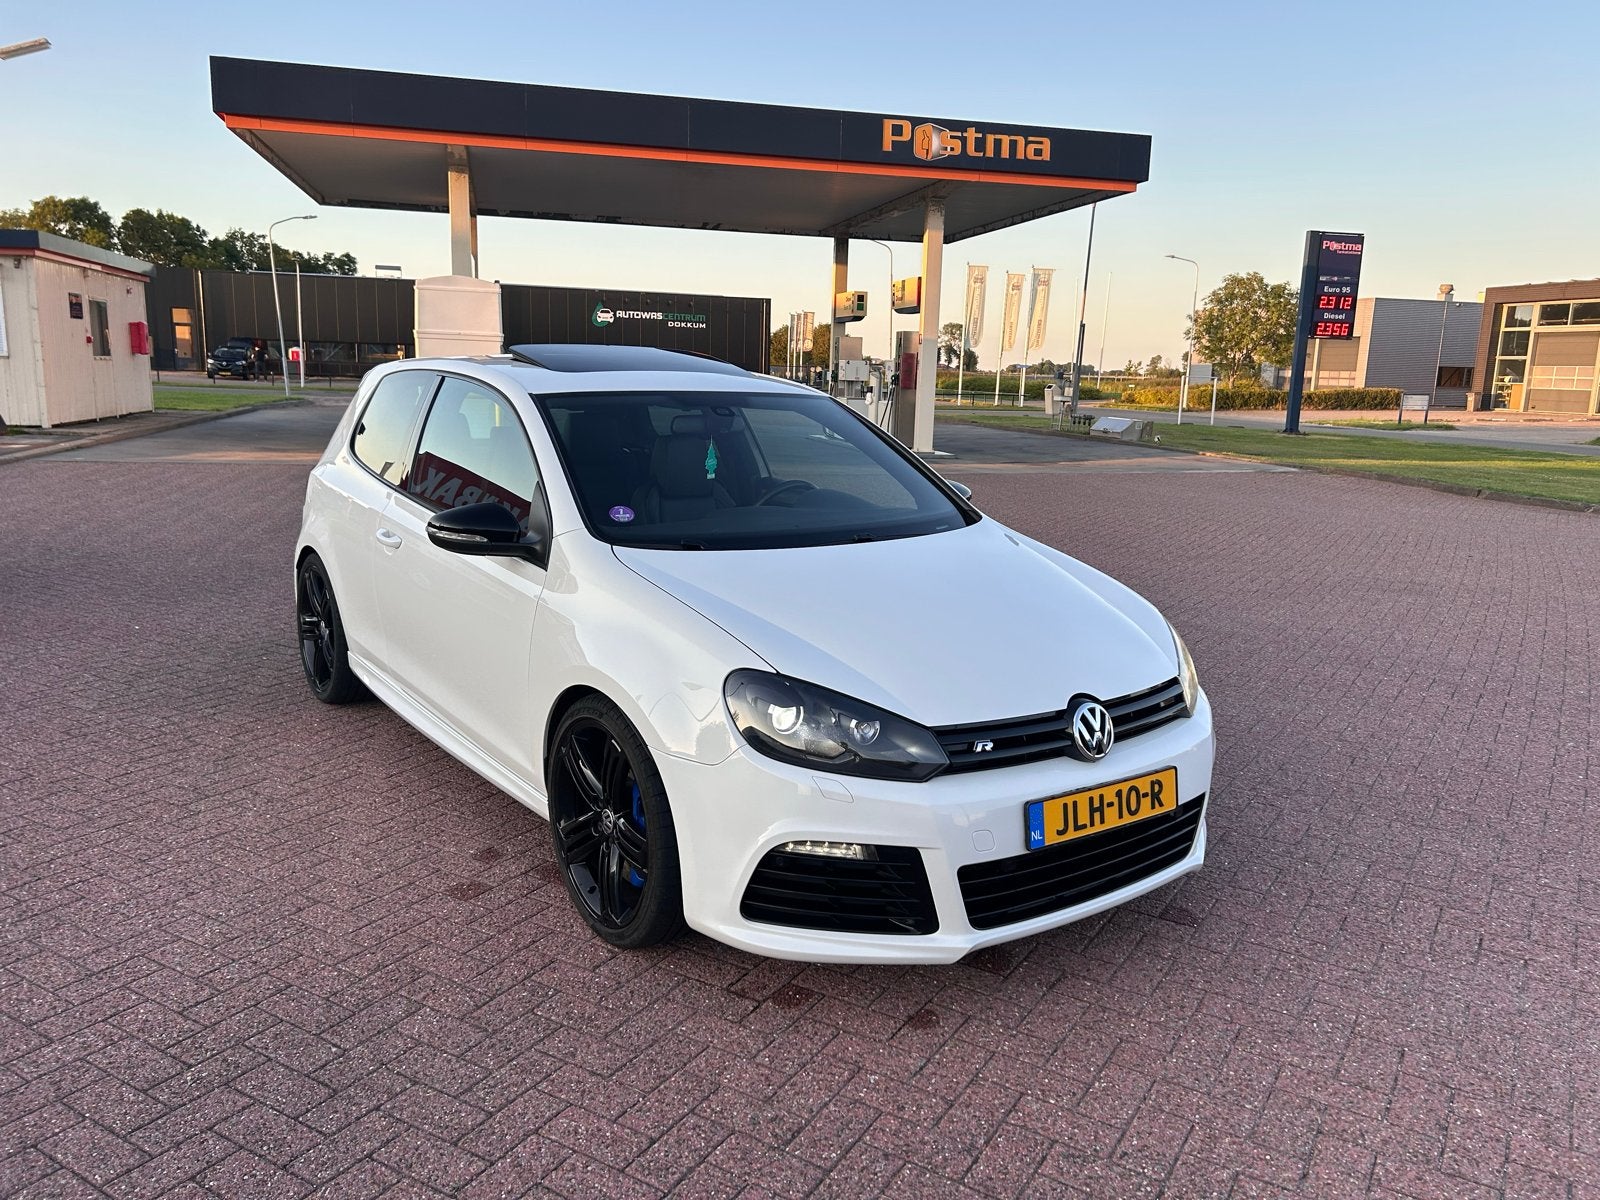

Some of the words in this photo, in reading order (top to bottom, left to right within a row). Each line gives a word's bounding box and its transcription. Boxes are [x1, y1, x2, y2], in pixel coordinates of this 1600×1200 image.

[882, 118, 1051, 161] Postma
[1322, 240, 1362, 251] Postma
[1323, 312, 1346, 320] Diesel
[668, 321, 706, 329] DOKKUM
[973, 740, 994, 753] R
[1056, 778, 1165, 836] JLH-10-R
[1031, 830, 1043, 840] NL
